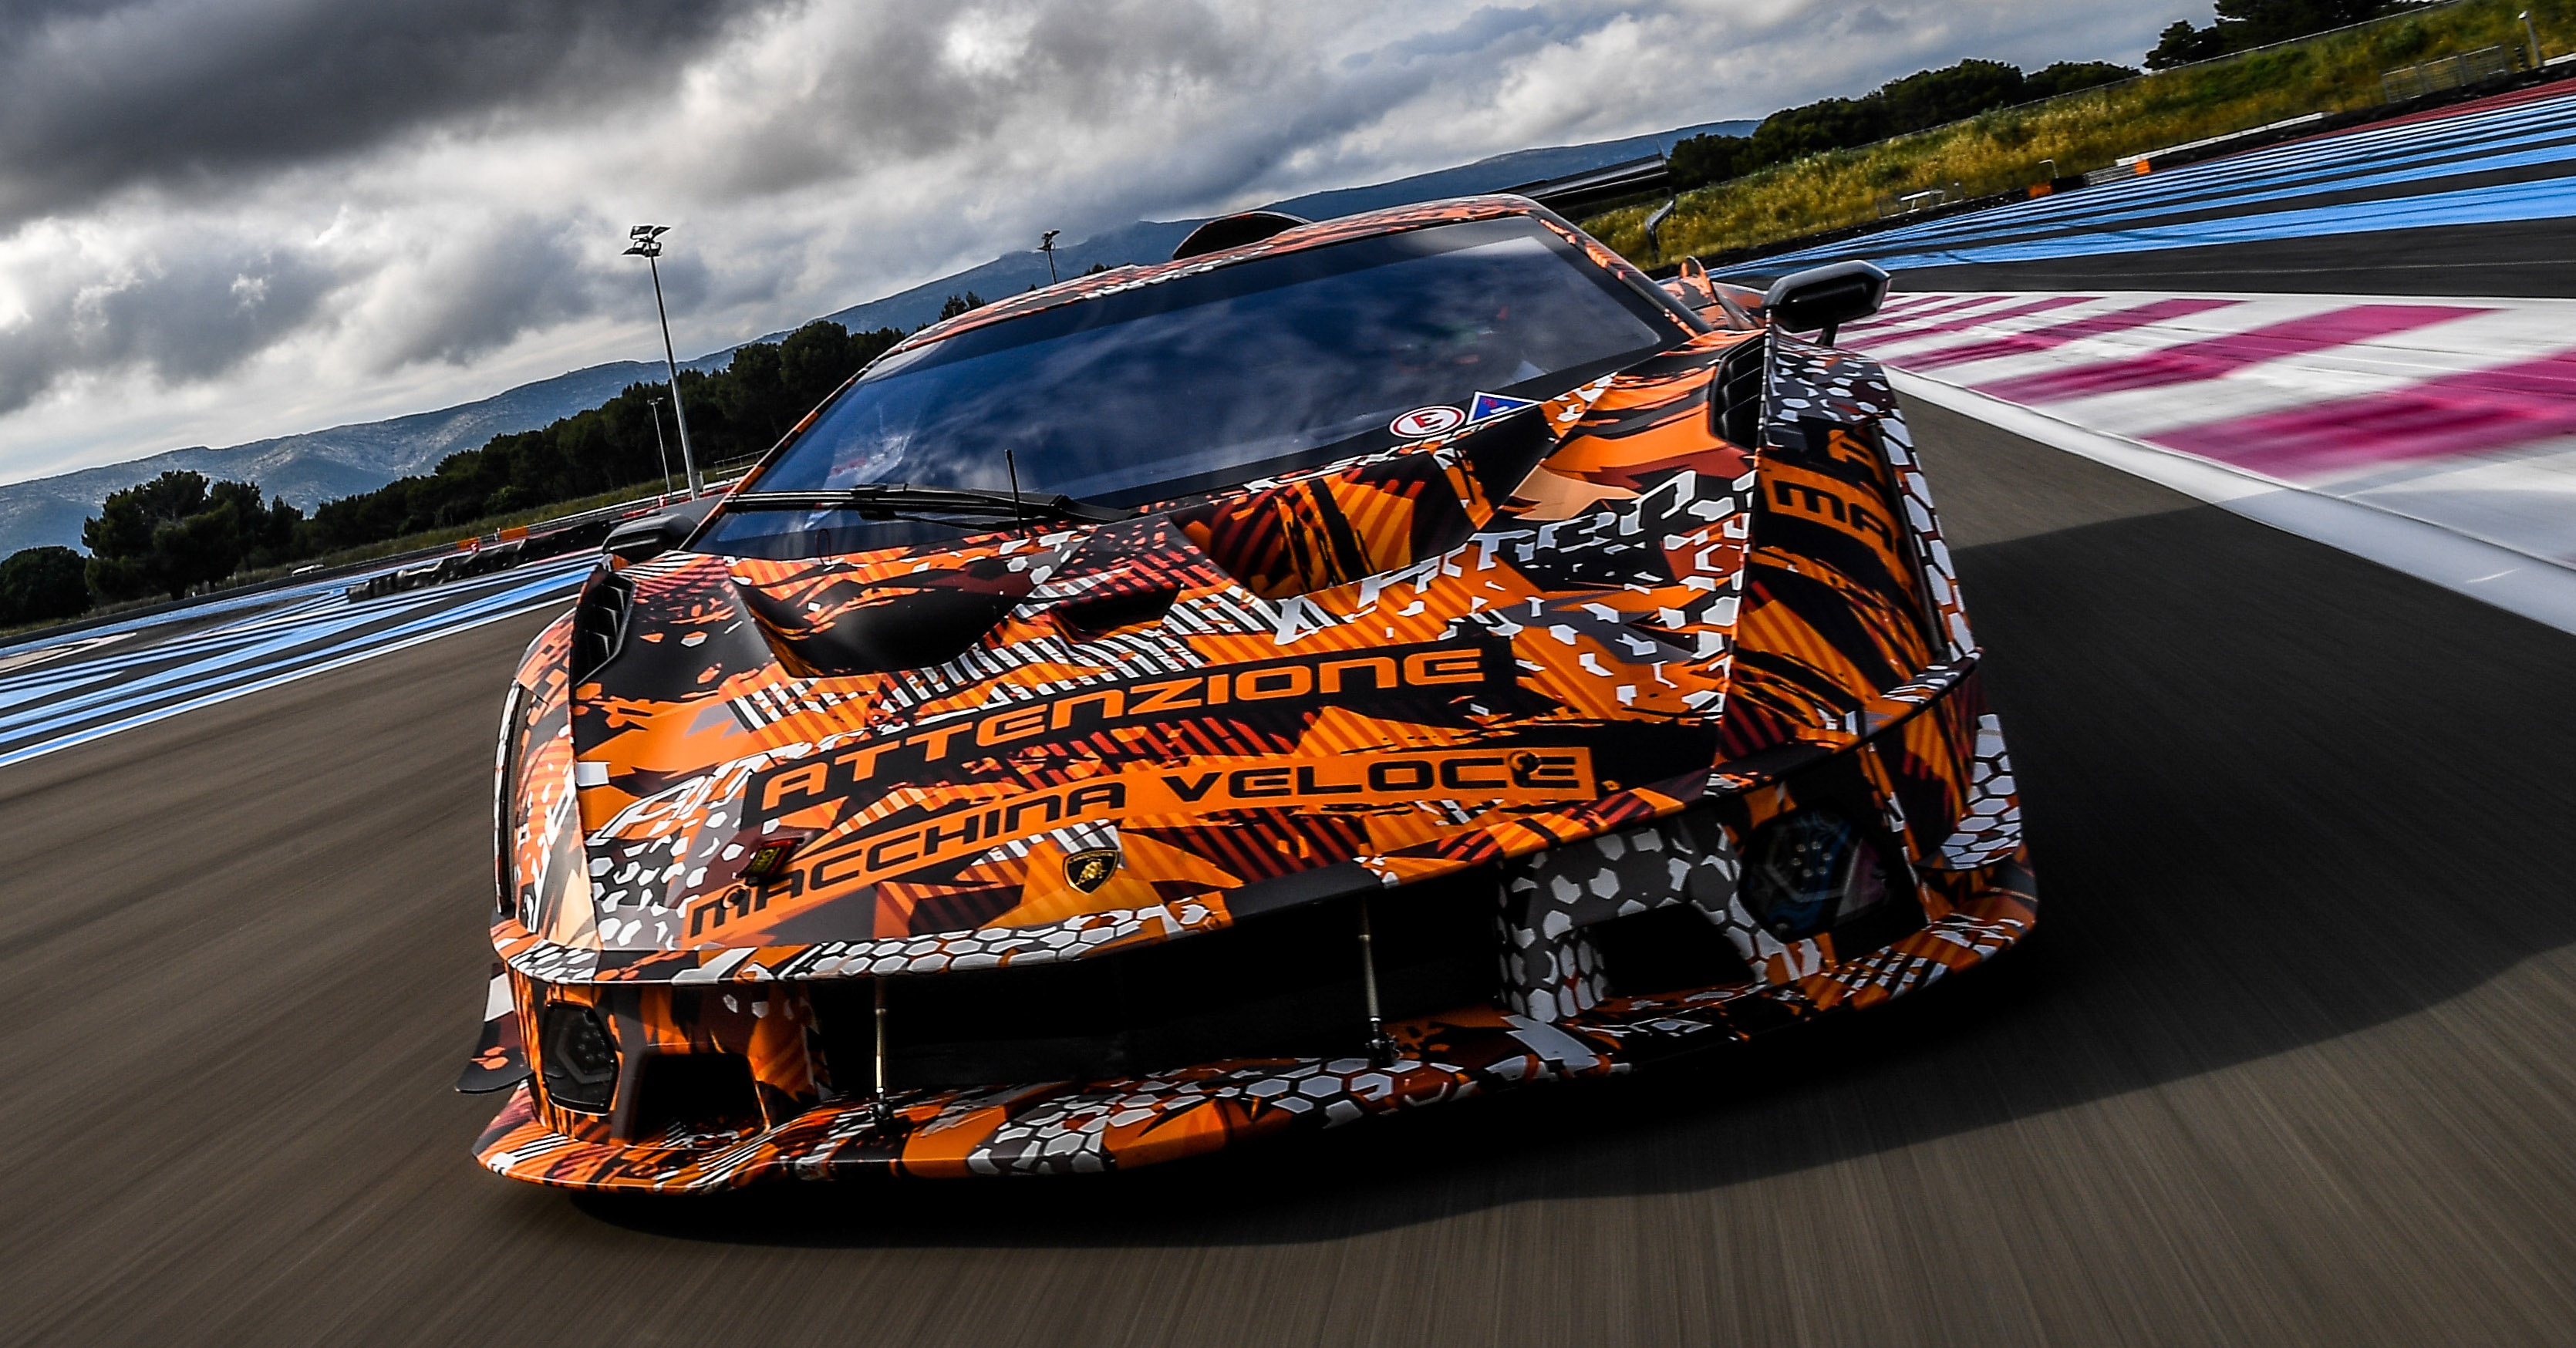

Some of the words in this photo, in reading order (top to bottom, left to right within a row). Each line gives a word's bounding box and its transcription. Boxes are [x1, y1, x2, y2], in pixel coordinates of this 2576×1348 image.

[762, 648, 1485, 811] ATTENZIONE
[690, 781, 1126, 939] MACCHINA
[1162, 756, 1580, 801] VELOCE
